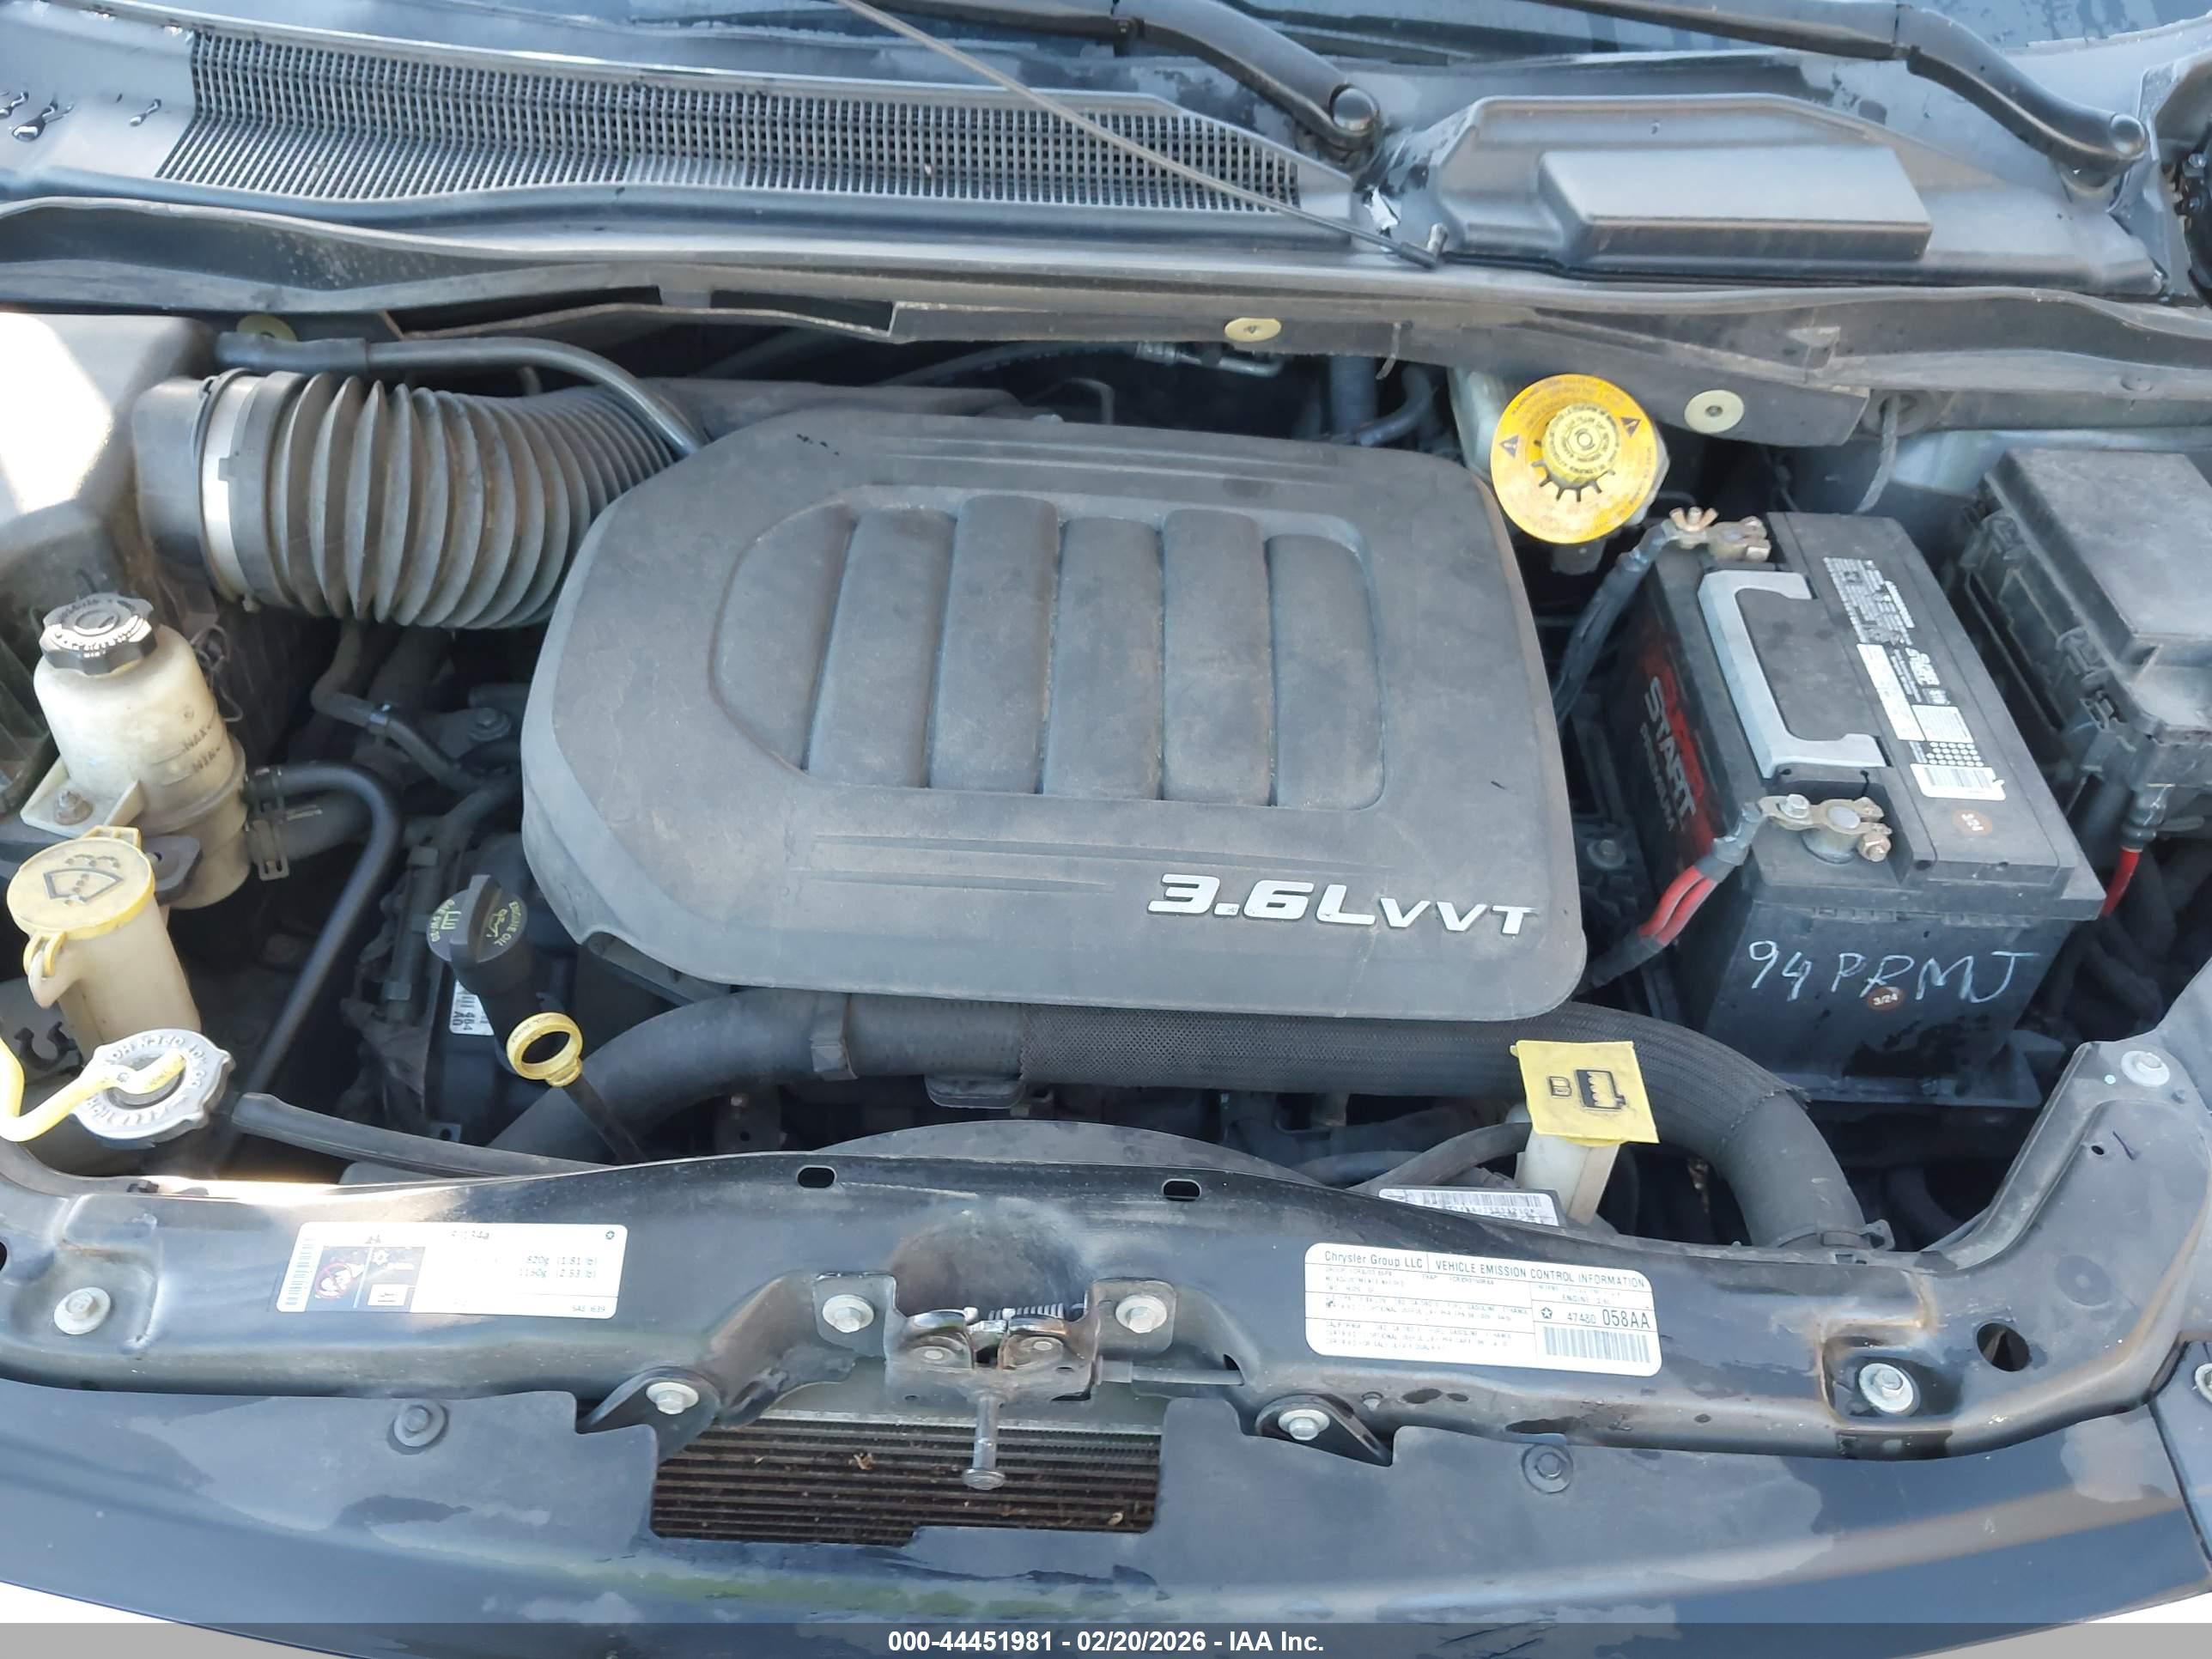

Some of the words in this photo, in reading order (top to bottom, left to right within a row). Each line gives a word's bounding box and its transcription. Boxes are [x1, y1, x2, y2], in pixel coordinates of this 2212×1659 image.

[1147, 872, 1376, 926] 3.6L
[1379, 896, 1542, 934] VVT
[494, 933, 513, 946] OIL
[1325, 1250, 1366, 1265] Chrysler
[1370, 1254, 1401, 1268] Group
[1404, 1257, 1423, 1268] LLC
[1436, 1260, 1476, 1273] VEHICLE
[1480, 1264, 1527, 1278] EMISSION
[1530, 1268, 1575, 1283] CONTROL
[1578, 1273, 1644, 1288] INFORMATION
[1602, 1309, 1650, 1329] 058AA
